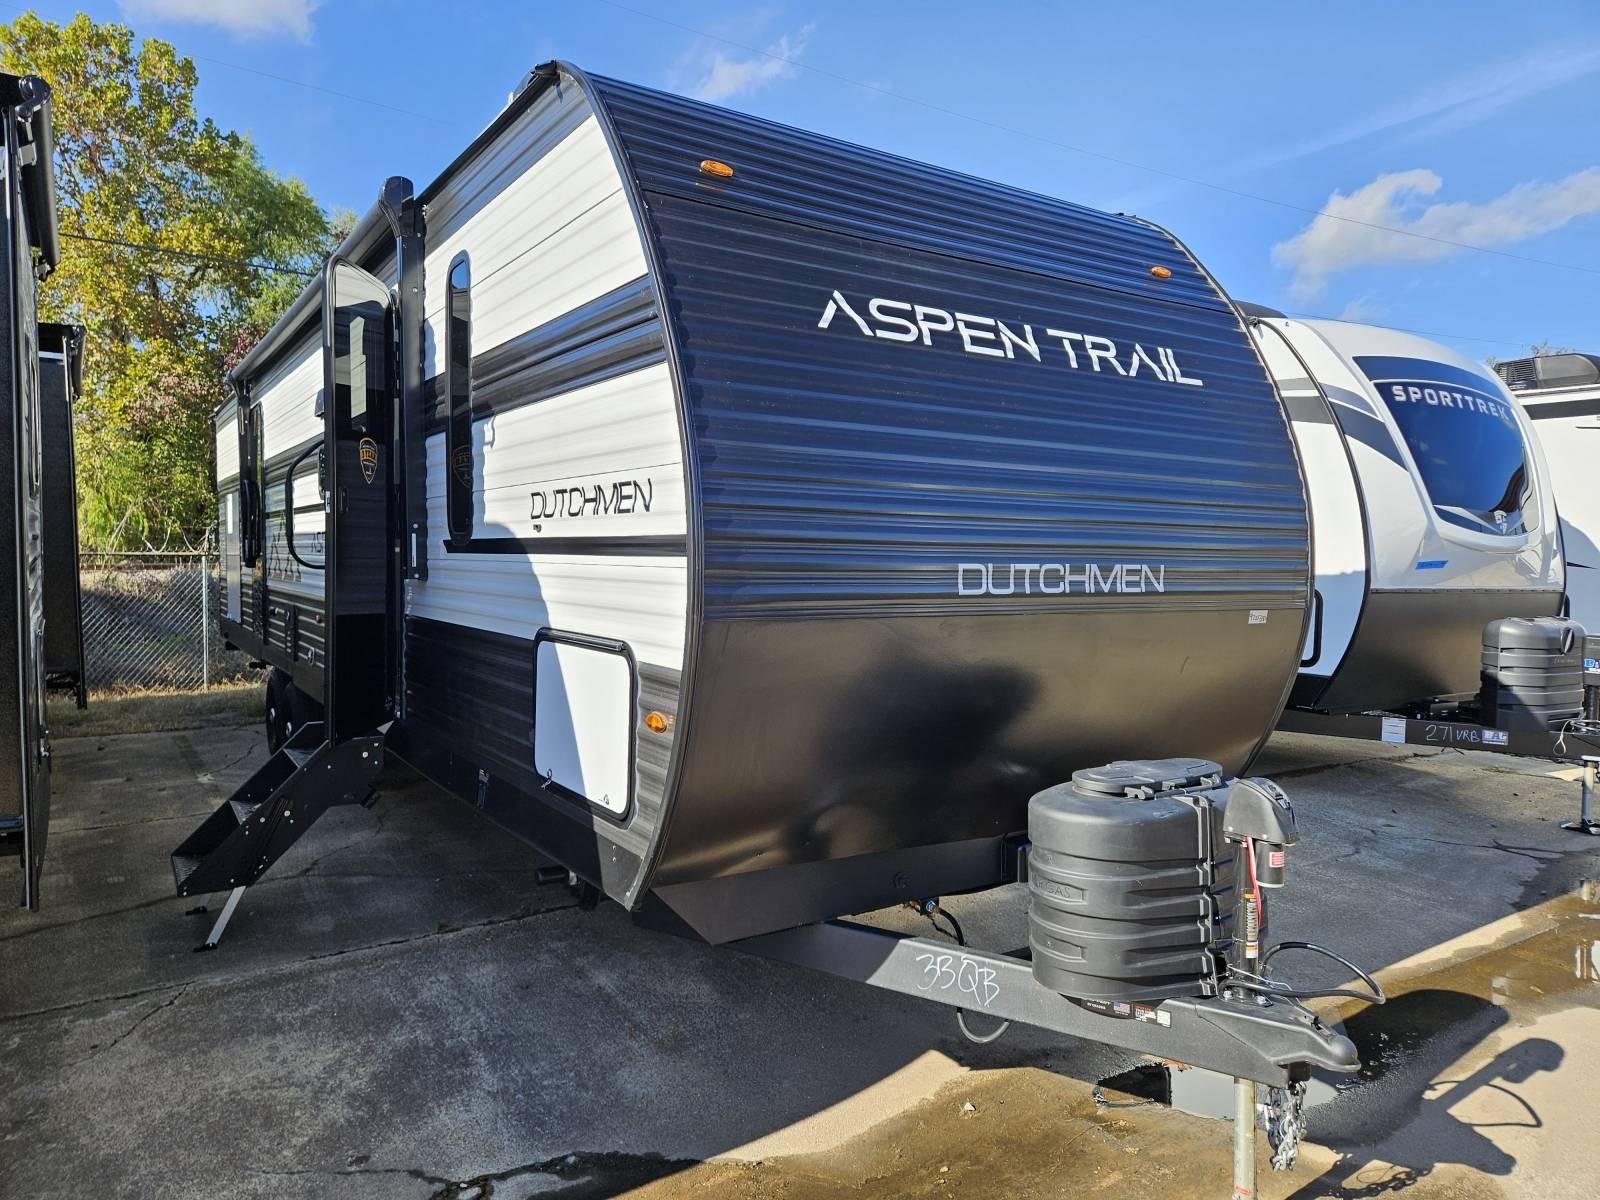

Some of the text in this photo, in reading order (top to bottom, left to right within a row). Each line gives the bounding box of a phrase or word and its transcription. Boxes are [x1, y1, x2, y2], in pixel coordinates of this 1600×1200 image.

[817, 289, 1204, 386] ASPEN TRAIL
[1391, 385, 1509, 420] SPORTTREK
[530, 478, 652, 521] DUTCHMEN
[957, 563, 1165, 595] DUTCHMEN
